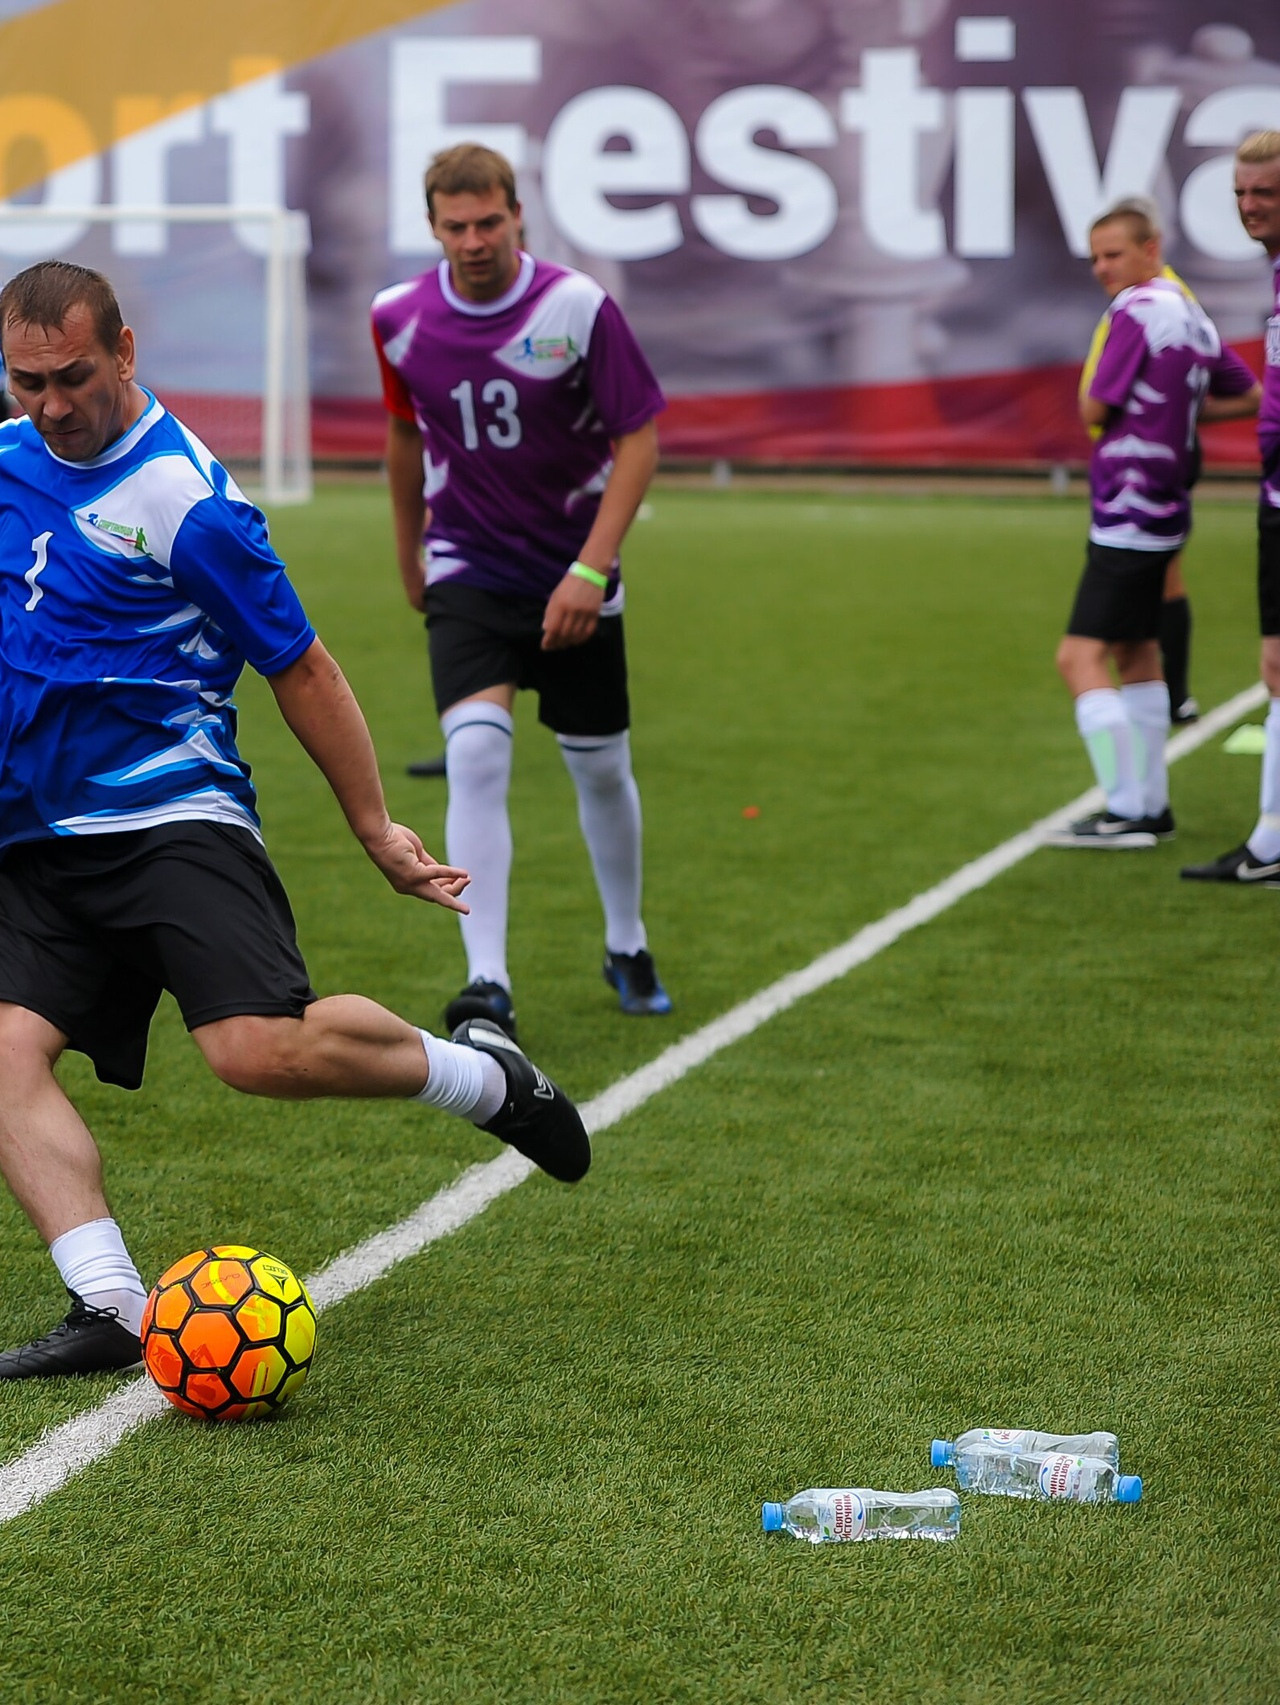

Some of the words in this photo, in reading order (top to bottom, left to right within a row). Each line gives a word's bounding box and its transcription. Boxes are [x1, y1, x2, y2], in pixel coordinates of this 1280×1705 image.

[450, 377, 522, 450] 13
[24, 531, 55, 612] 1
[833, 1498, 843, 1535] Святой
